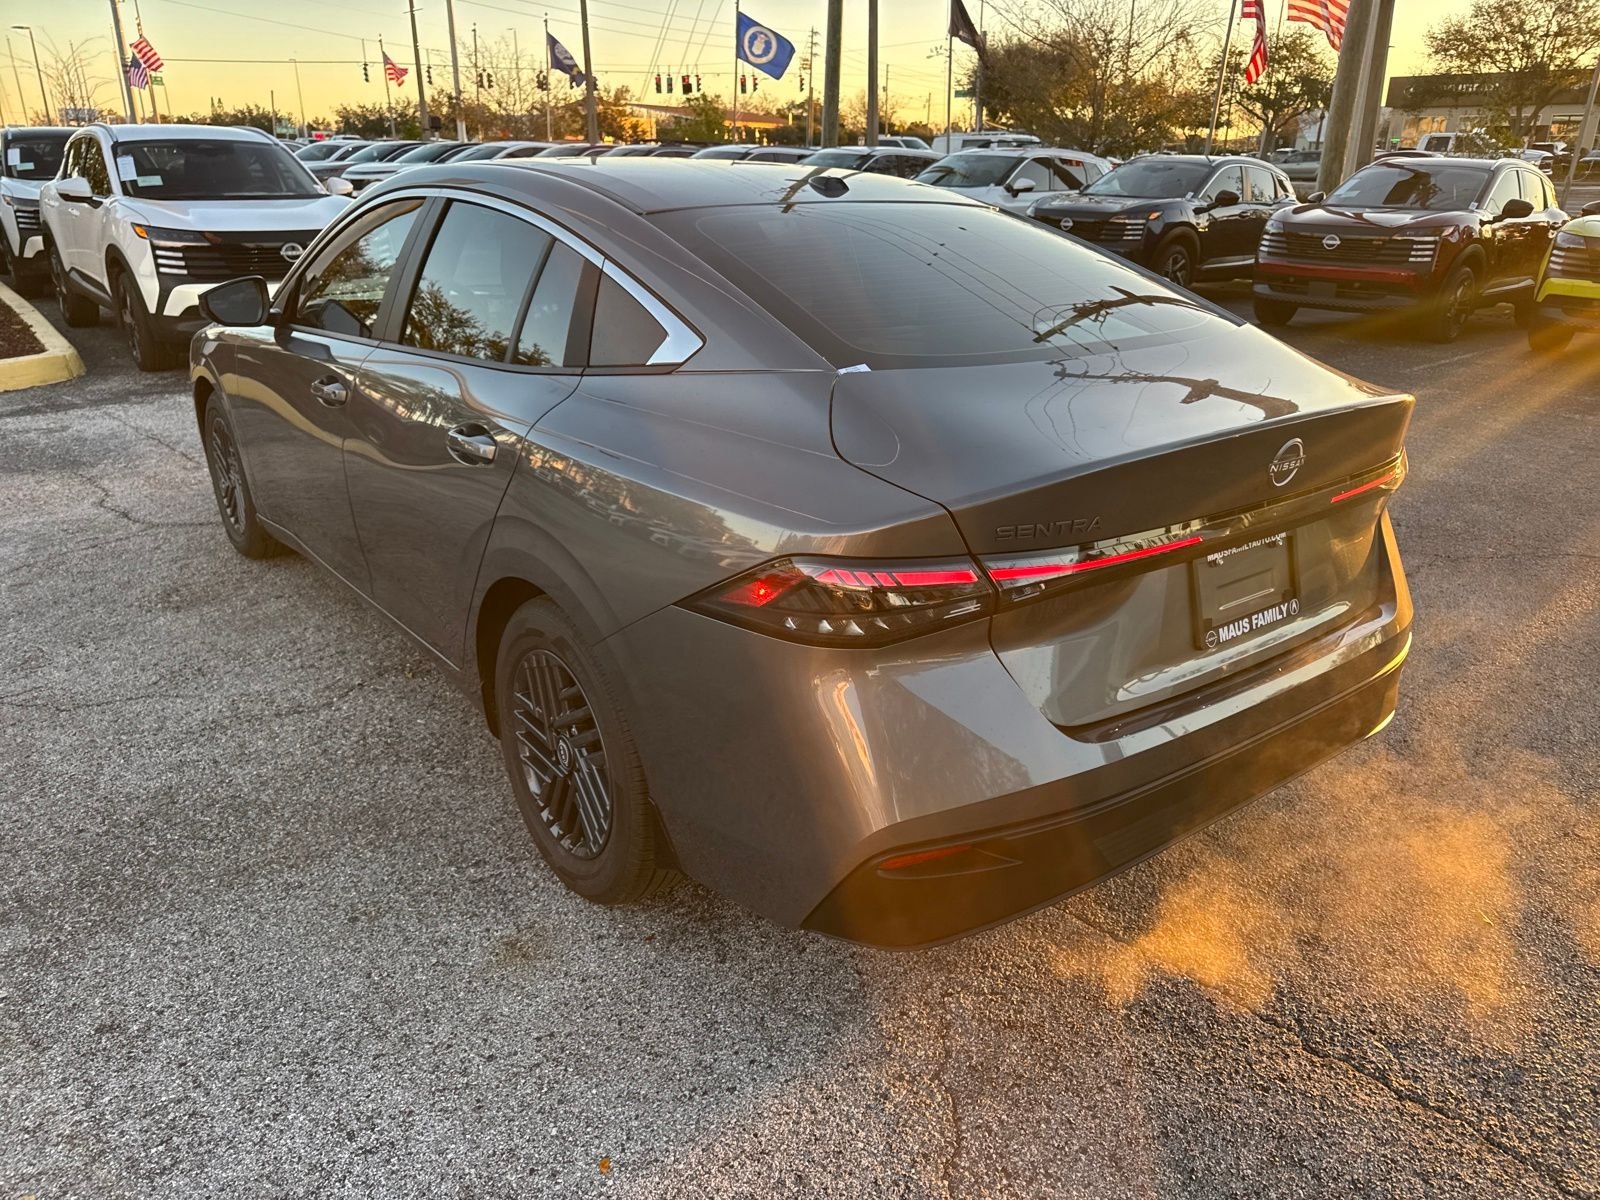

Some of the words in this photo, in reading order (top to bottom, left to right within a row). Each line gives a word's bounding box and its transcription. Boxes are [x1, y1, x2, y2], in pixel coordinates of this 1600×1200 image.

[994, 516, 1101, 541] SENTRA
[1219, 617, 1250, 643] MAUS
[1252, 602, 1288, 630] FAMILY
